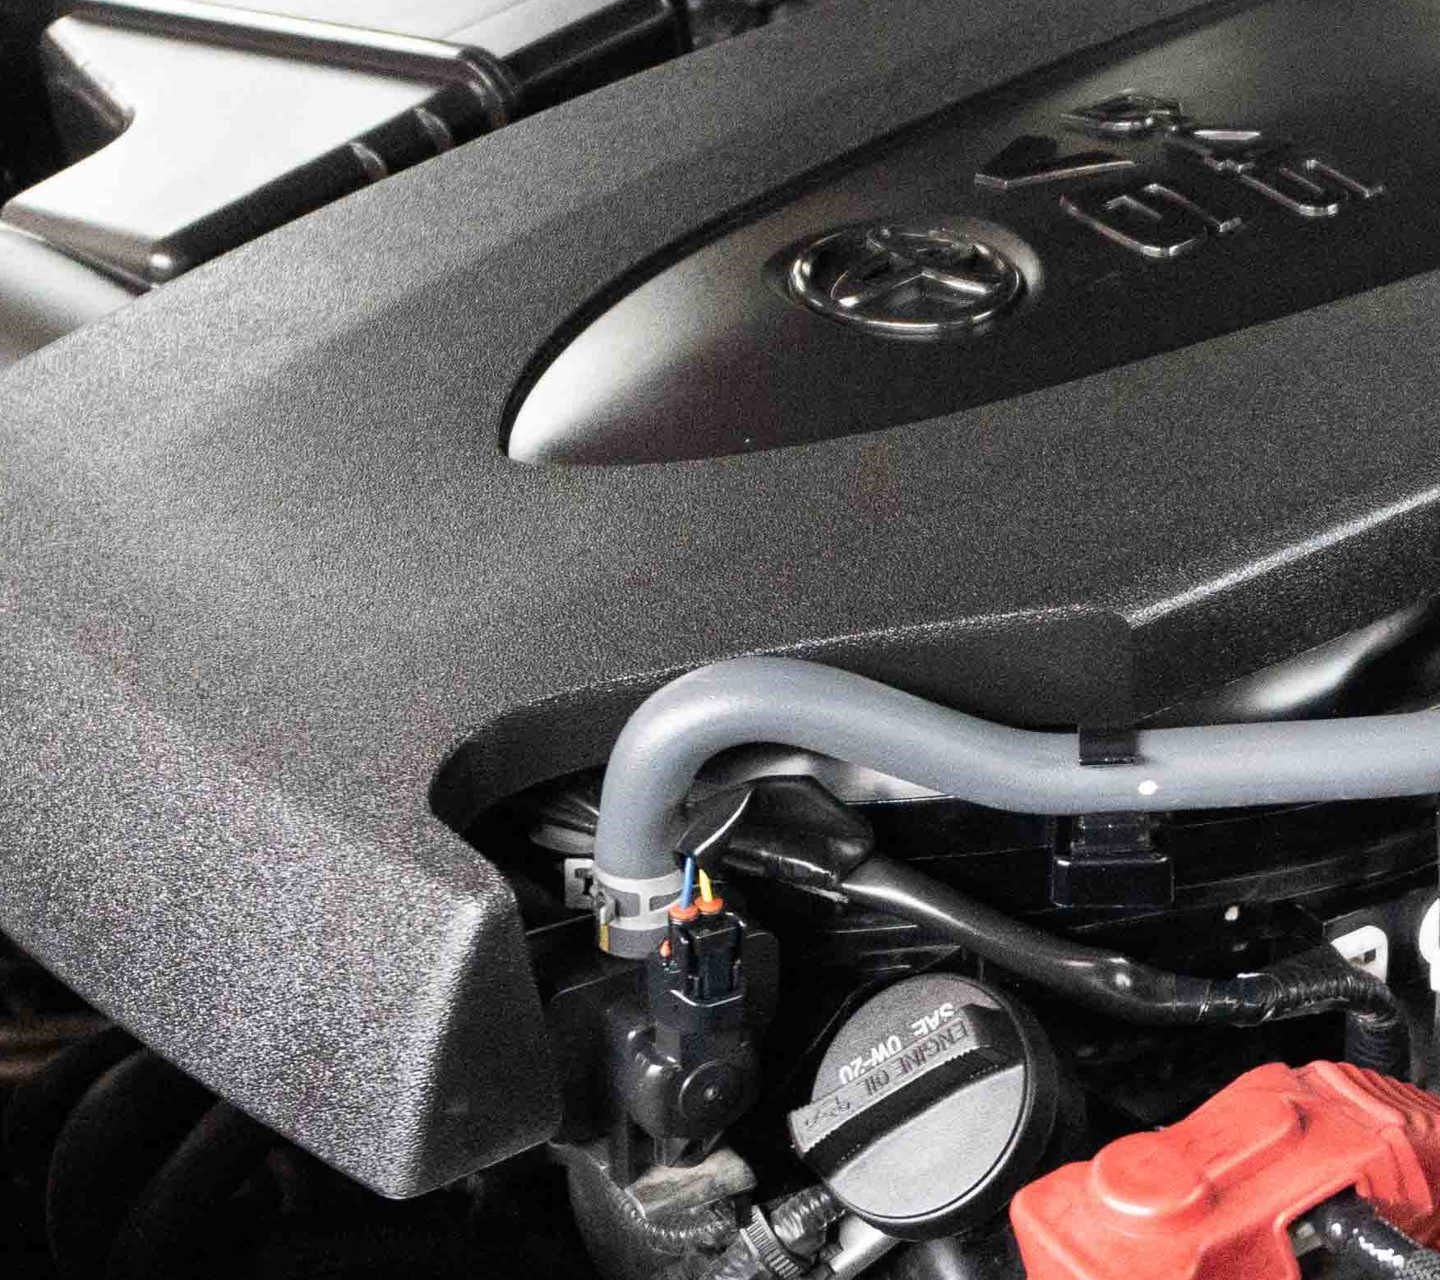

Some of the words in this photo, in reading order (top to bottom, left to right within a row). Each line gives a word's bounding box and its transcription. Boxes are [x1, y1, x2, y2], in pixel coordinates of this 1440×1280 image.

[910, 1002, 957, 1037] SAE
[898, 1019, 970, 1070] ENGINE
[864, 1069, 891, 1096] OIL
